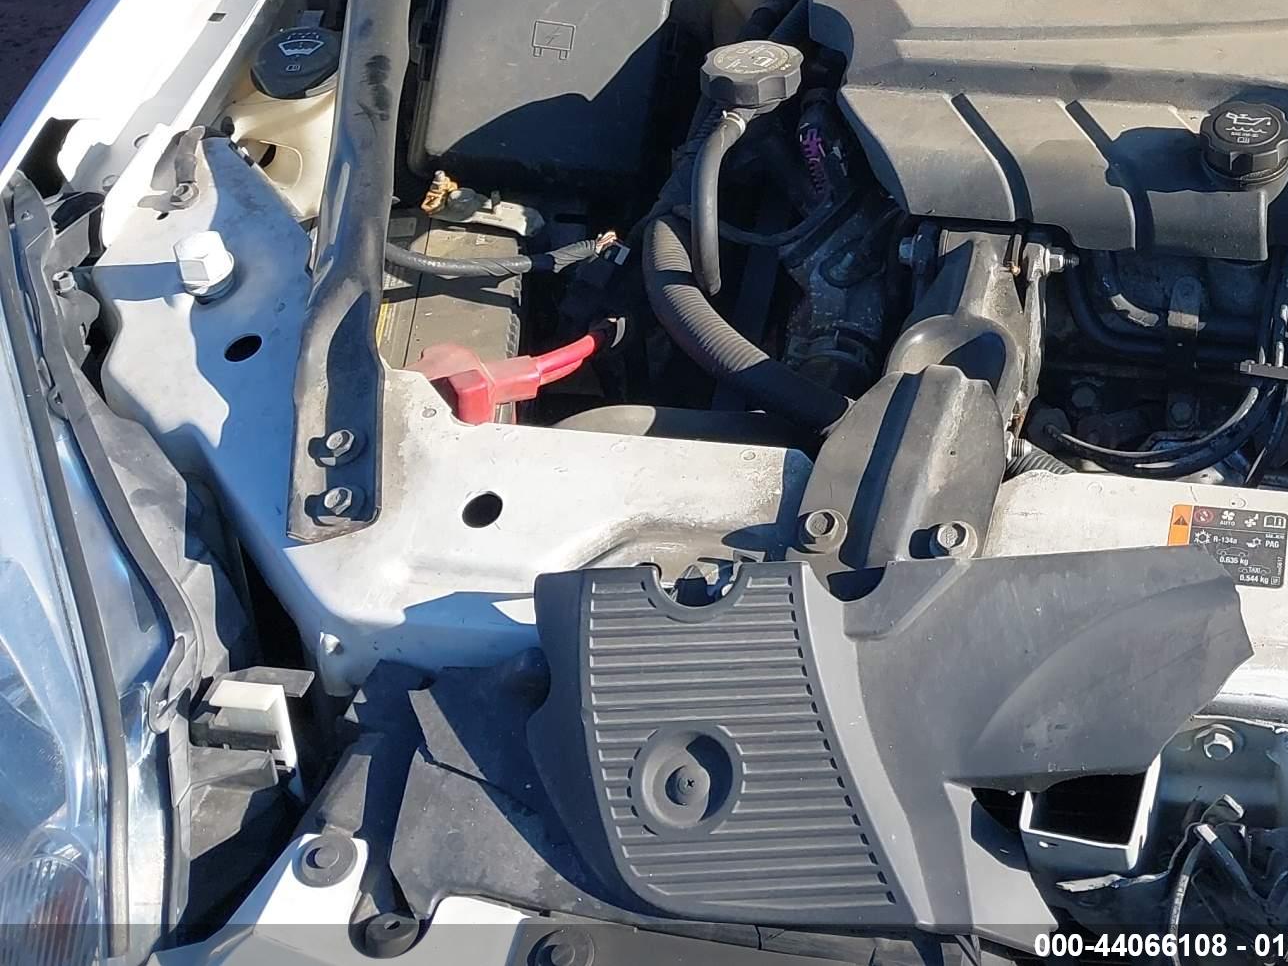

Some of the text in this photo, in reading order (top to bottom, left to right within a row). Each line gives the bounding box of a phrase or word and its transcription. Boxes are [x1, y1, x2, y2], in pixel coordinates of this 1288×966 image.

[1213, 535, 1238, 544] R-134a
[1265, 540, 1280, 548] PAG
[1240, 557, 1249, 566] kg
[1239, 574, 1259, 582] 0.544
[1259, 576, 1269, 584] kg
